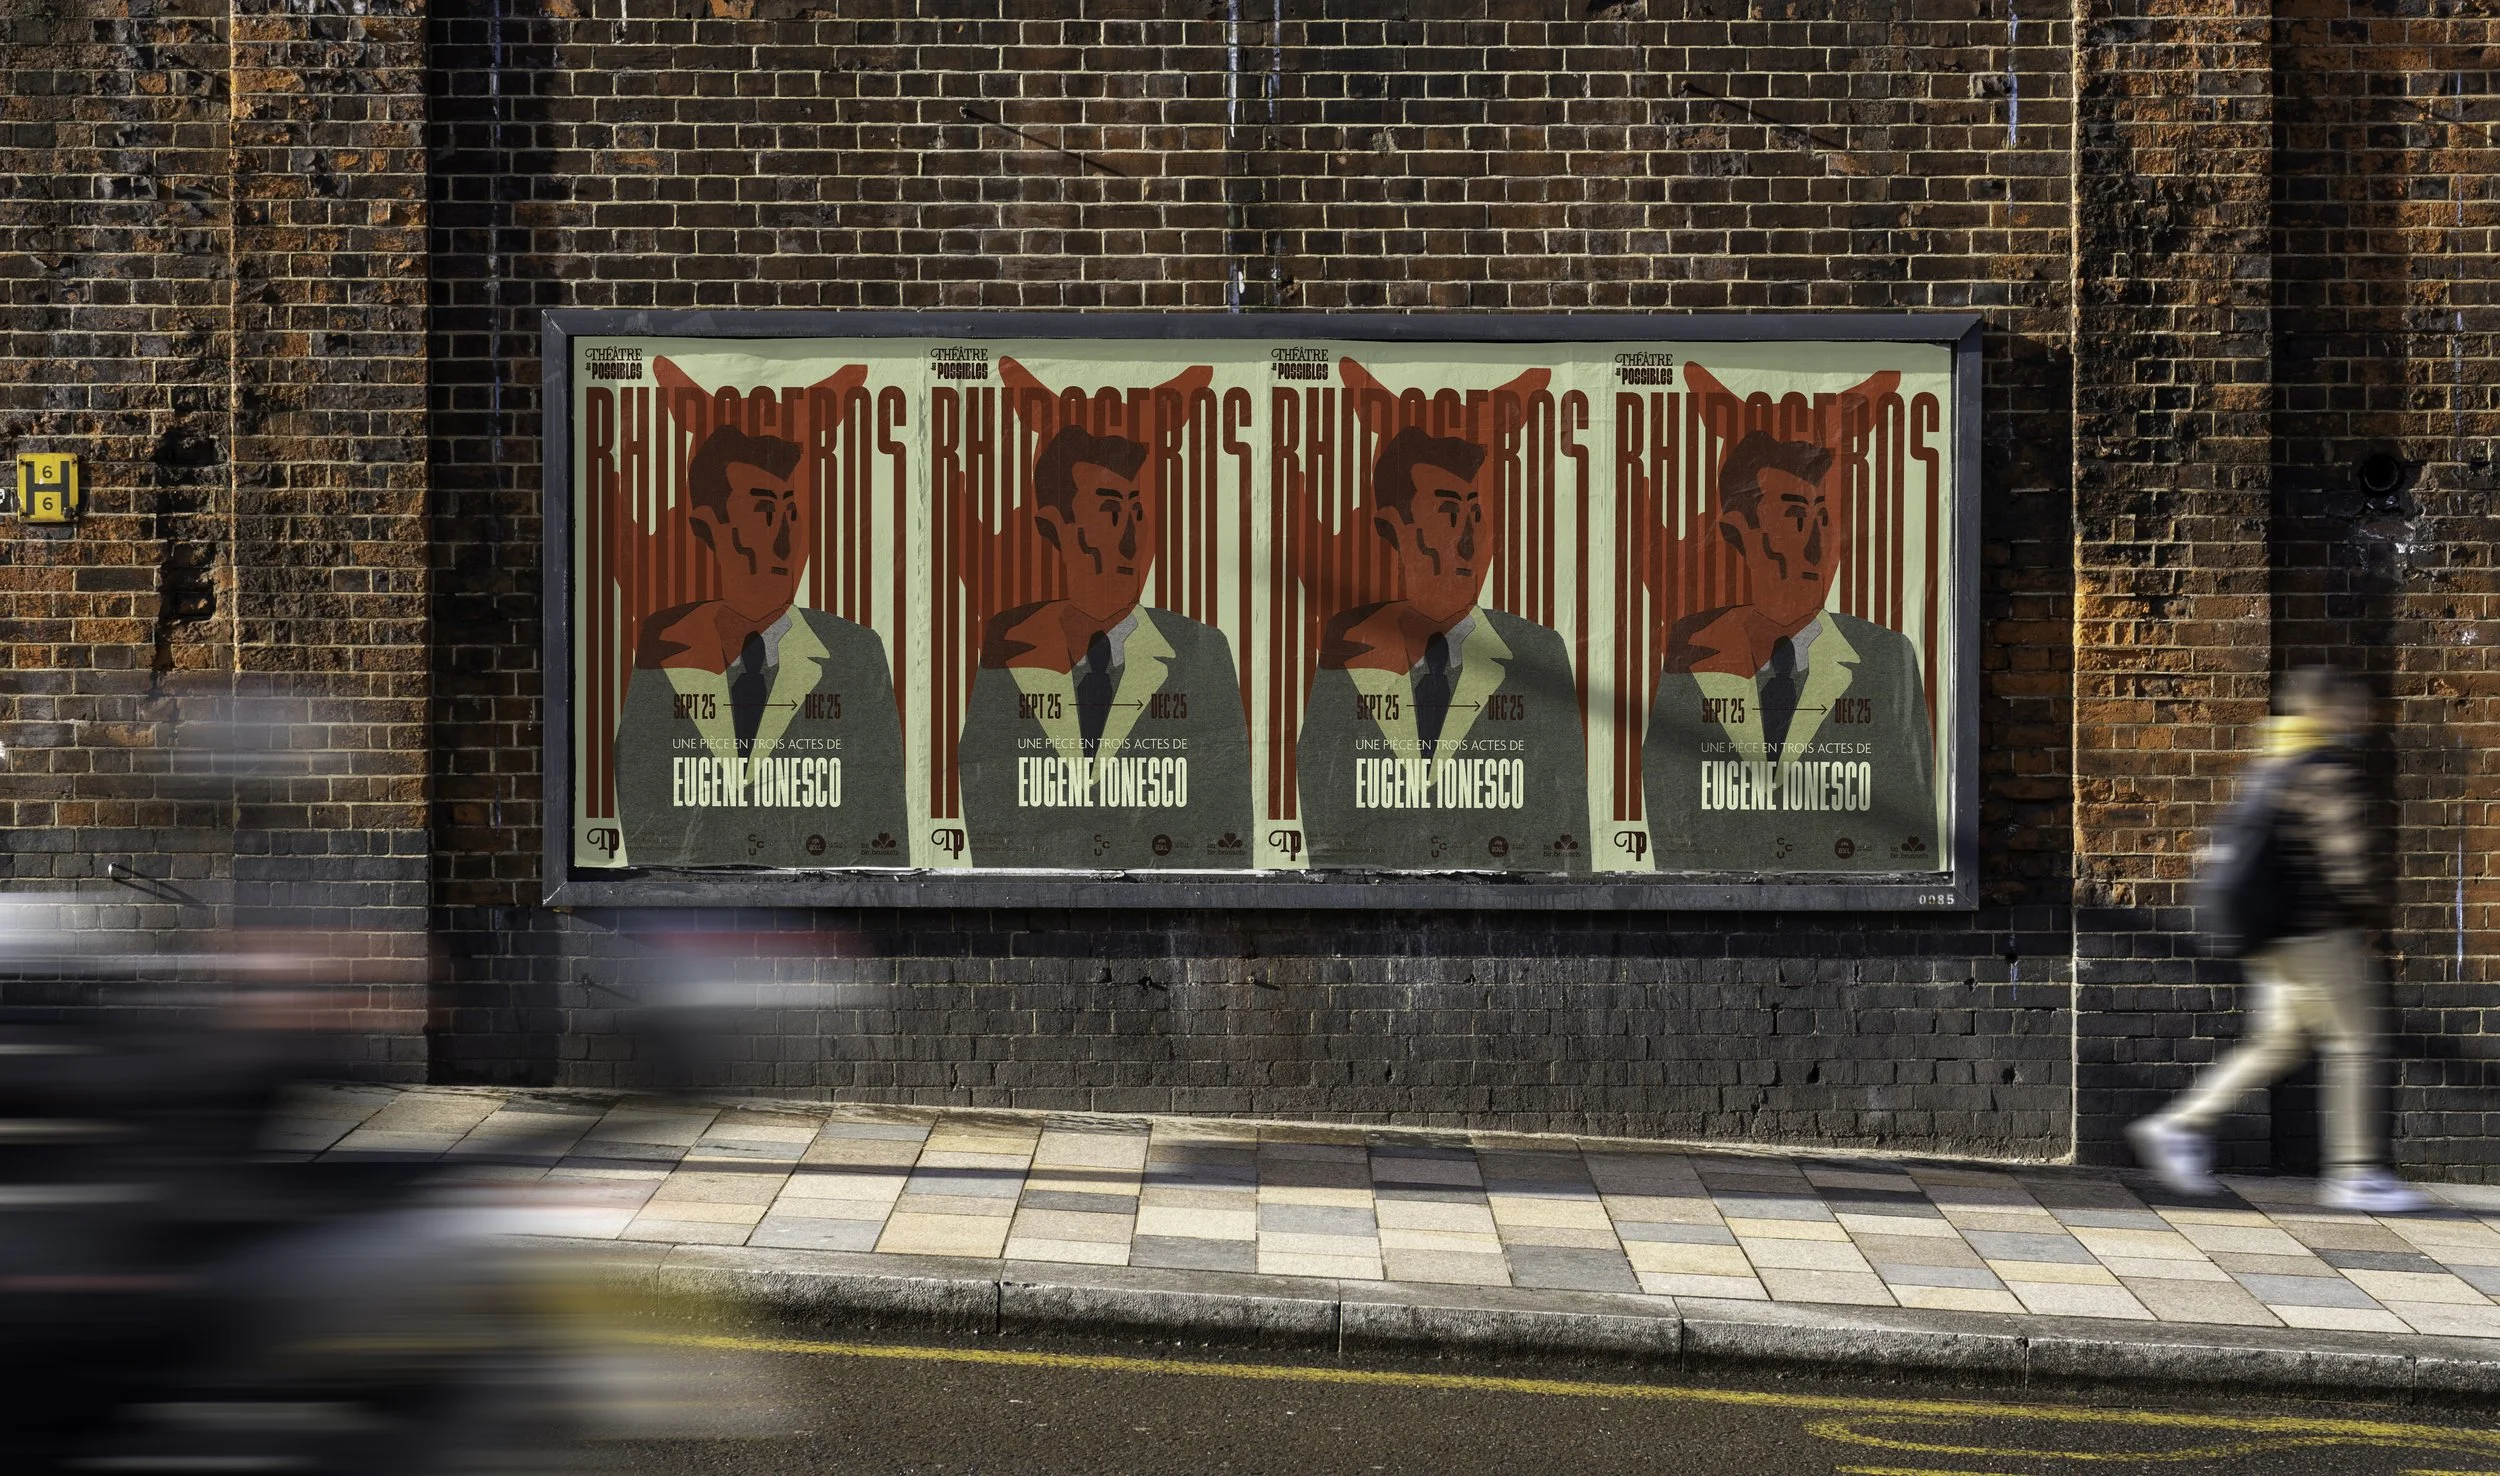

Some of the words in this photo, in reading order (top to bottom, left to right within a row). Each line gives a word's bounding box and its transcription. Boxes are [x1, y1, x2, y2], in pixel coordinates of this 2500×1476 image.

[585, 346, 642, 360] THÉÂTRE
[930, 346, 988, 360] THÉÂTRE
[1271, 347, 1328, 361] THÉÂTRE
[1615, 351, 1673, 365] THÉÂTRE
[592, 363, 642, 379] POSSIBLES
[937, 363, 988, 379] POSSIBLES
[1278, 364, 1328, 379] POSSIBLES
[1622, 368, 1672, 384] POSSIBLES
[42, 466, 53, 478] 6
[26, 461, 70, 515] H
[43, 497, 53, 510] 6
[674, 694, 698, 719] SEPT
[702, 694, 715, 719] 25
[805, 694, 824, 719] DEC
[827, 694, 841, 719] 25
[1019, 694, 1043, 719] SEPT
[1047, 694, 1061, 719] 25
[1151, 694, 1170, 719] DEC
[1173, 694, 1187, 719] 25
[1357, 695, 1381, 720] SEPT
[1385, 695, 1398, 720] 25
[1488, 695, 1507, 720] DEC
[1510, 695, 1524, 720] 25
[1703, 698, 1727, 723] SEPT
[1731, 698, 1744, 723] 25
[1835, 698, 1854, 723] DEC
[1857, 698, 1871, 723] 25
[673, 739, 696, 749] UNE
[701, 735, 729, 749] PIÈCE
[733, 739, 748, 749] EN
[751, 739, 784, 749] TROIS
[788, 739, 823, 749] ACTES
[827, 739, 841, 749] DE
[1018, 739, 1041, 749] UNE
[1046, 735, 1075, 749] PIÈCE
[1079, 739, 1094, 749] EN
[1097, 739, 1130, 749] TROIS
[1134, 739, 1169, 749] ACTES
[1173, 739, 1187, 749] DE
[1356, 740, 1379, 750] UNE
[1384, 736, 1412, 750] PIÈCE
[1416, 740, 1431, 750] EN
[1434, 740, 1467, 750] TROIS
[1471, 740, 1506, 750] ACTES
[1510, 740, 1524, 750] DE
[1701, 743, 1725, 753] UNE
[1730, 739, 1758, 753] PIÈCE
[1762, 743, 1777, 753] EN
[1780, 743, 1813, 753] TROIS
[1817, 743, 1853, 753] ACTES
[1857, 743, 1871, 753] DE
[674, 757, 748, 807] EUGENE
[754, 757, 841, 807] IONESCO
[1019, 757, 1094, 807] EUGENE
[1100, 757, 1187, 807] IONESCO
[1357, 758, 1431, 808] EUGENE
[1437, 758, 1524, 808] IONESCO
[1702, 761, 1777, 810] EUGENE
[1783, 761, 1871, 811] IONESCO
[1919, 894, 1955, 905] 0085
